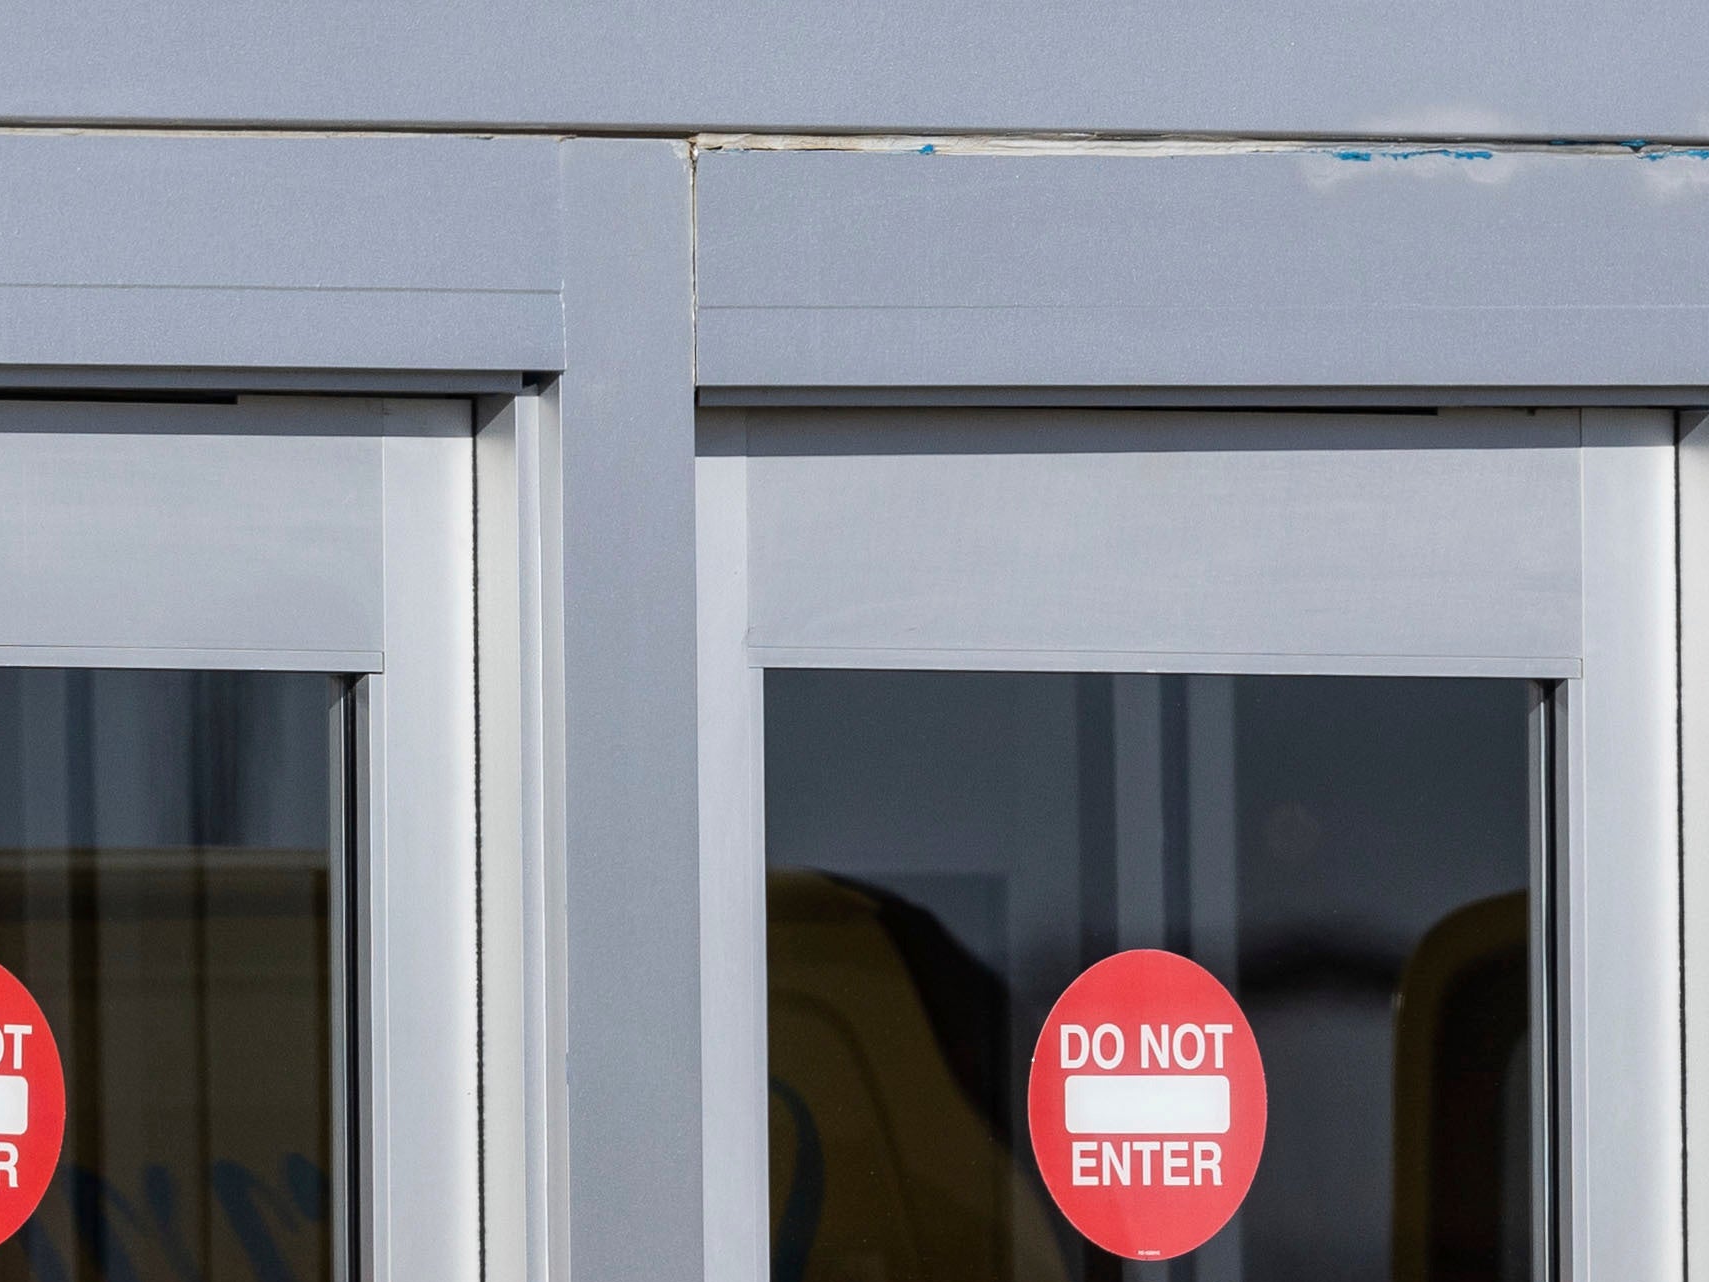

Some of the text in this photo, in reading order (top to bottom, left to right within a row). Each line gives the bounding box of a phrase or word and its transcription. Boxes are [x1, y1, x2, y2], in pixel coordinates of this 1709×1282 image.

[1060, 1023, 1232, 1071] DO NOT
[1073, 1140, 1222, 1187] ENTER
